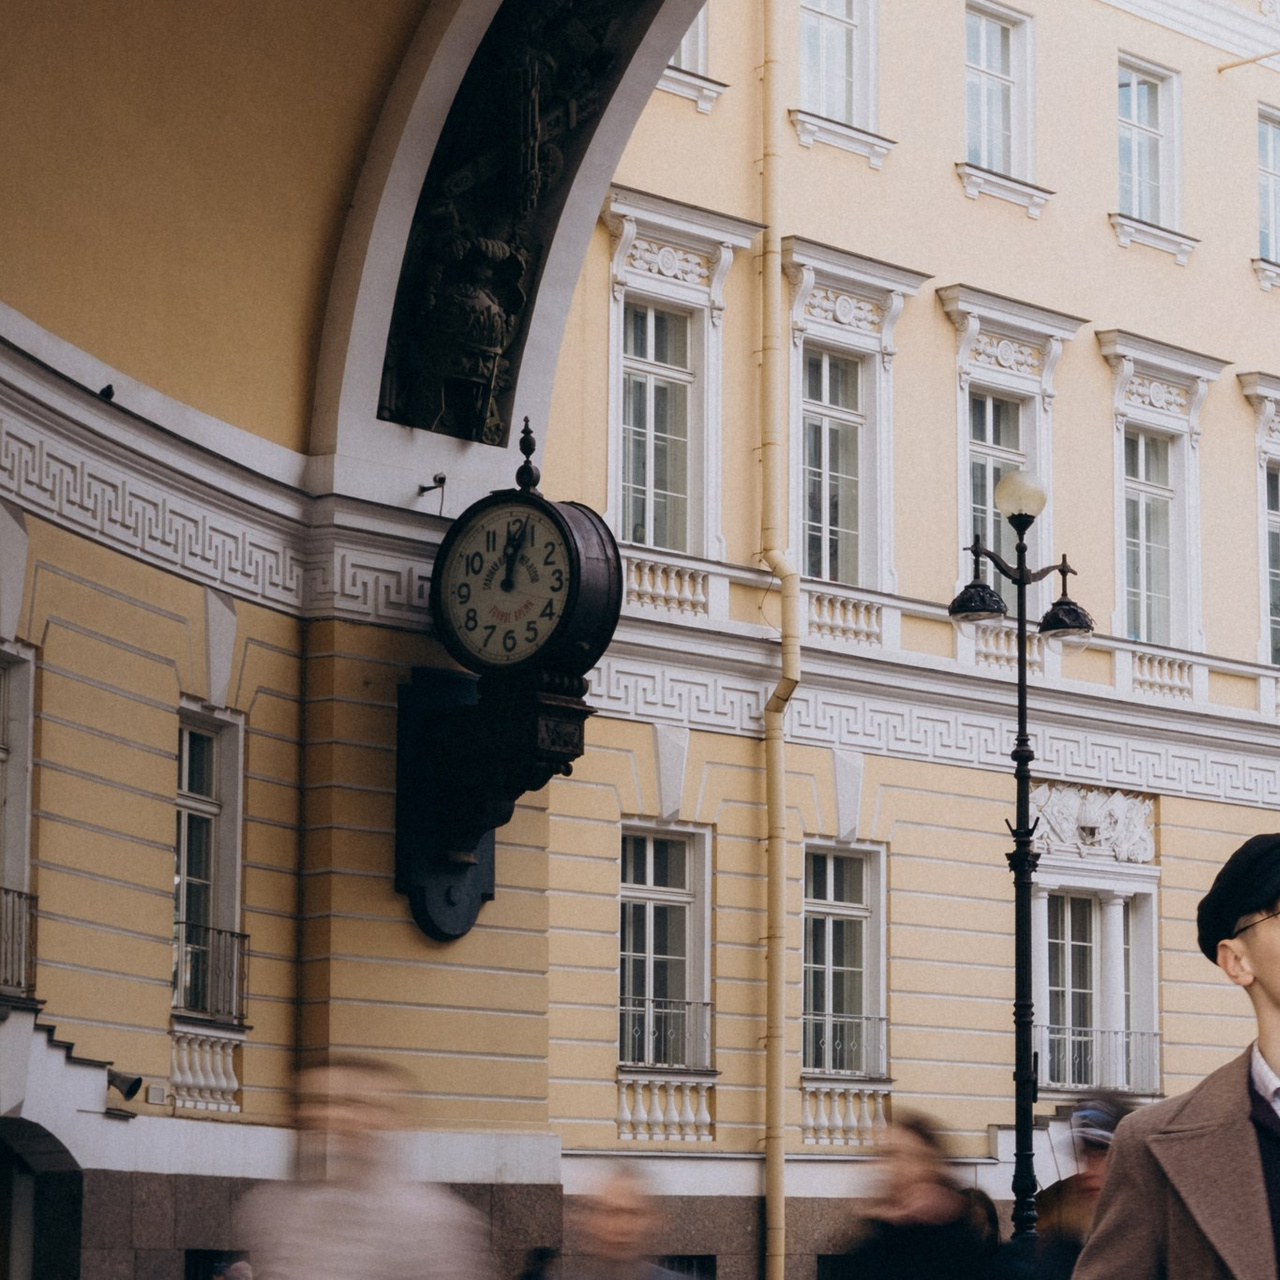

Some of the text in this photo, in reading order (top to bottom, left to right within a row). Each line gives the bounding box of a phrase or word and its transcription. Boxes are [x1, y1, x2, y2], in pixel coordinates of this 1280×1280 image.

[485, 529, 496, 553] 11
[530, 524, 535, 547] 1
[465, 551, 484, 577] 10
[543, 542, 556, 566] 2
[550, 569, 564, 593] 3
[457, 582, 471, 605] 9
[464, 608, 478, 632] 8
[539, 598, 556, 620] 4
[483, 624, 497, 648] 7
[503, 630, 517, 653] 6
[524, 621, 538, 644] 5
